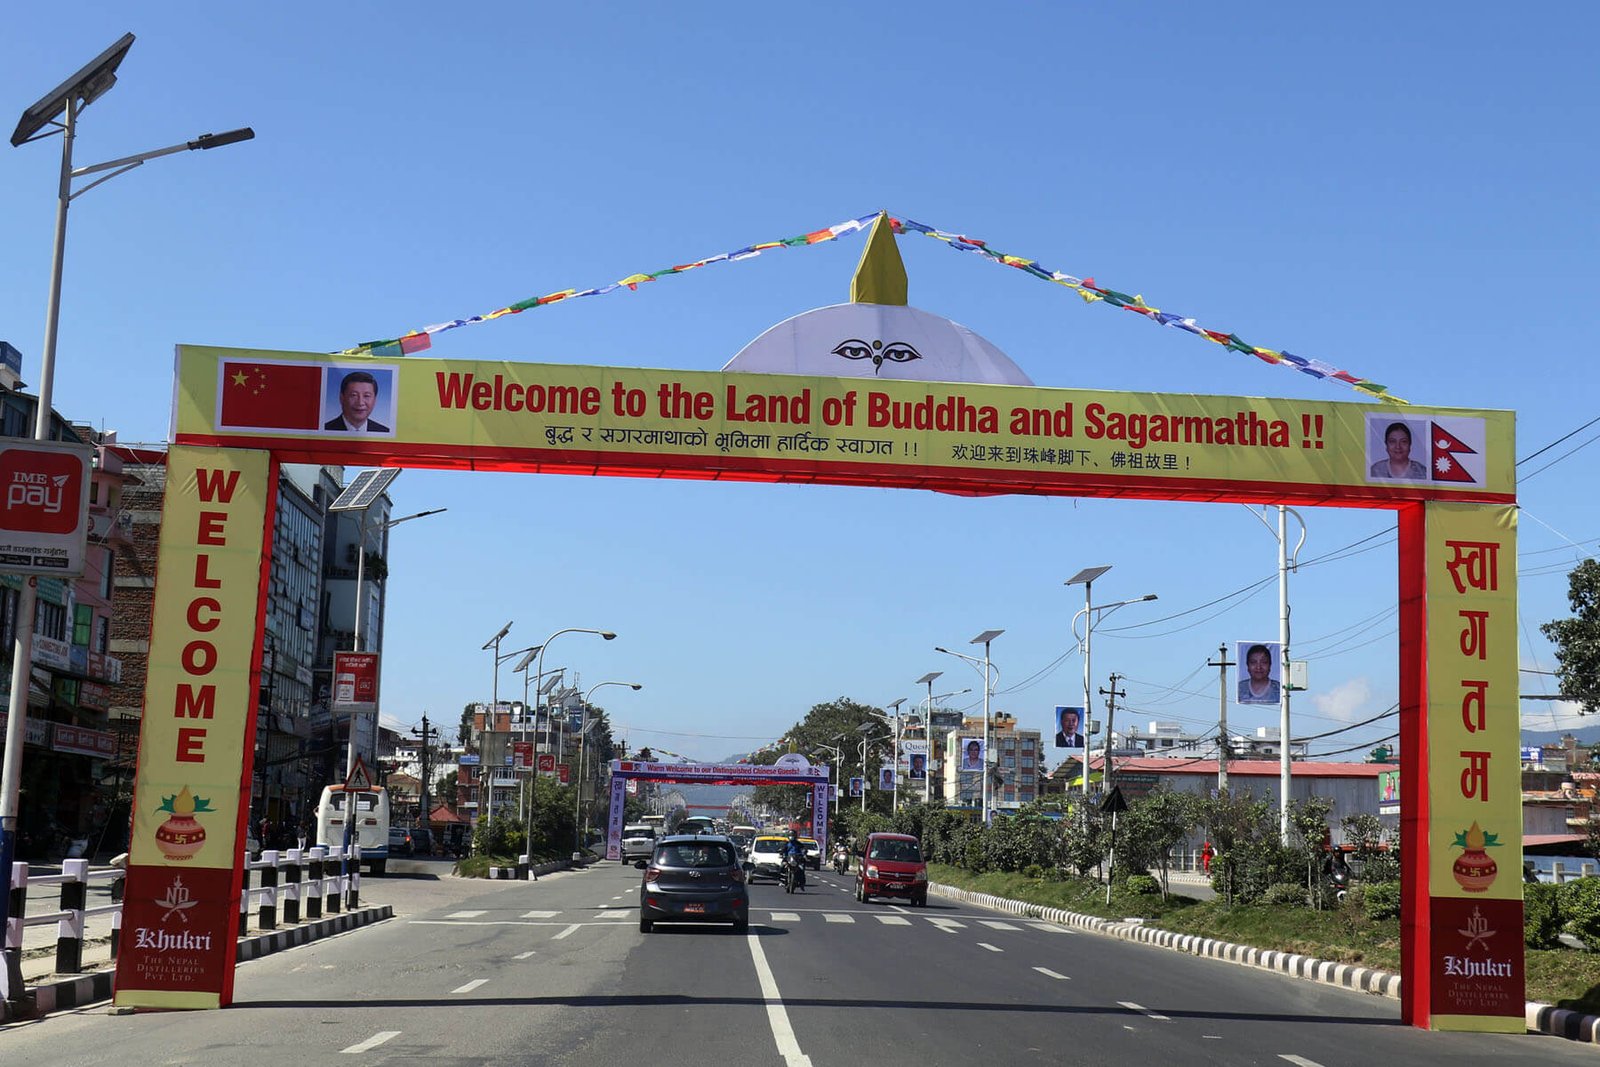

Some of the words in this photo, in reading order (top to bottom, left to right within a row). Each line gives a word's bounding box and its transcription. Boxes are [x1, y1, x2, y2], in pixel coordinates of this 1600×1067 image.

[436, 371, 601, 415] Welcome
[611, 382, 647, 416] to
[657, 383, 714, 421] the
[726, 385, 811, 425] Land
[822, 390, 857, 427] of
[868, 392, 999, 433] Buddha
[1009, 402, 1073, 437] and
[1084, 402, 1290, 449] Sagarmatha
[1302, 414, 1324, 449] !!
[544, 425, 575, 446] बुद्ध
[580, 427, 594, 443] र
[598, 426, 708, 447] सगरमाथाको
[713, 430, 772, 453] भूमिमा
[776, 431, 831, 453] हार्दिक
[836, 437, 894, 456] स्वागत
[904, 441, 919, 457] !!
[13, 471, 47, 485] IME
[7, 483, 63, 513] pay
[175, 468, 241, 763] WELCOME
[815, 785, 826, 835] WELCOME
[135, 927, 211, 952] Khukri
[1443, 956, 1512, 979] Khukri
